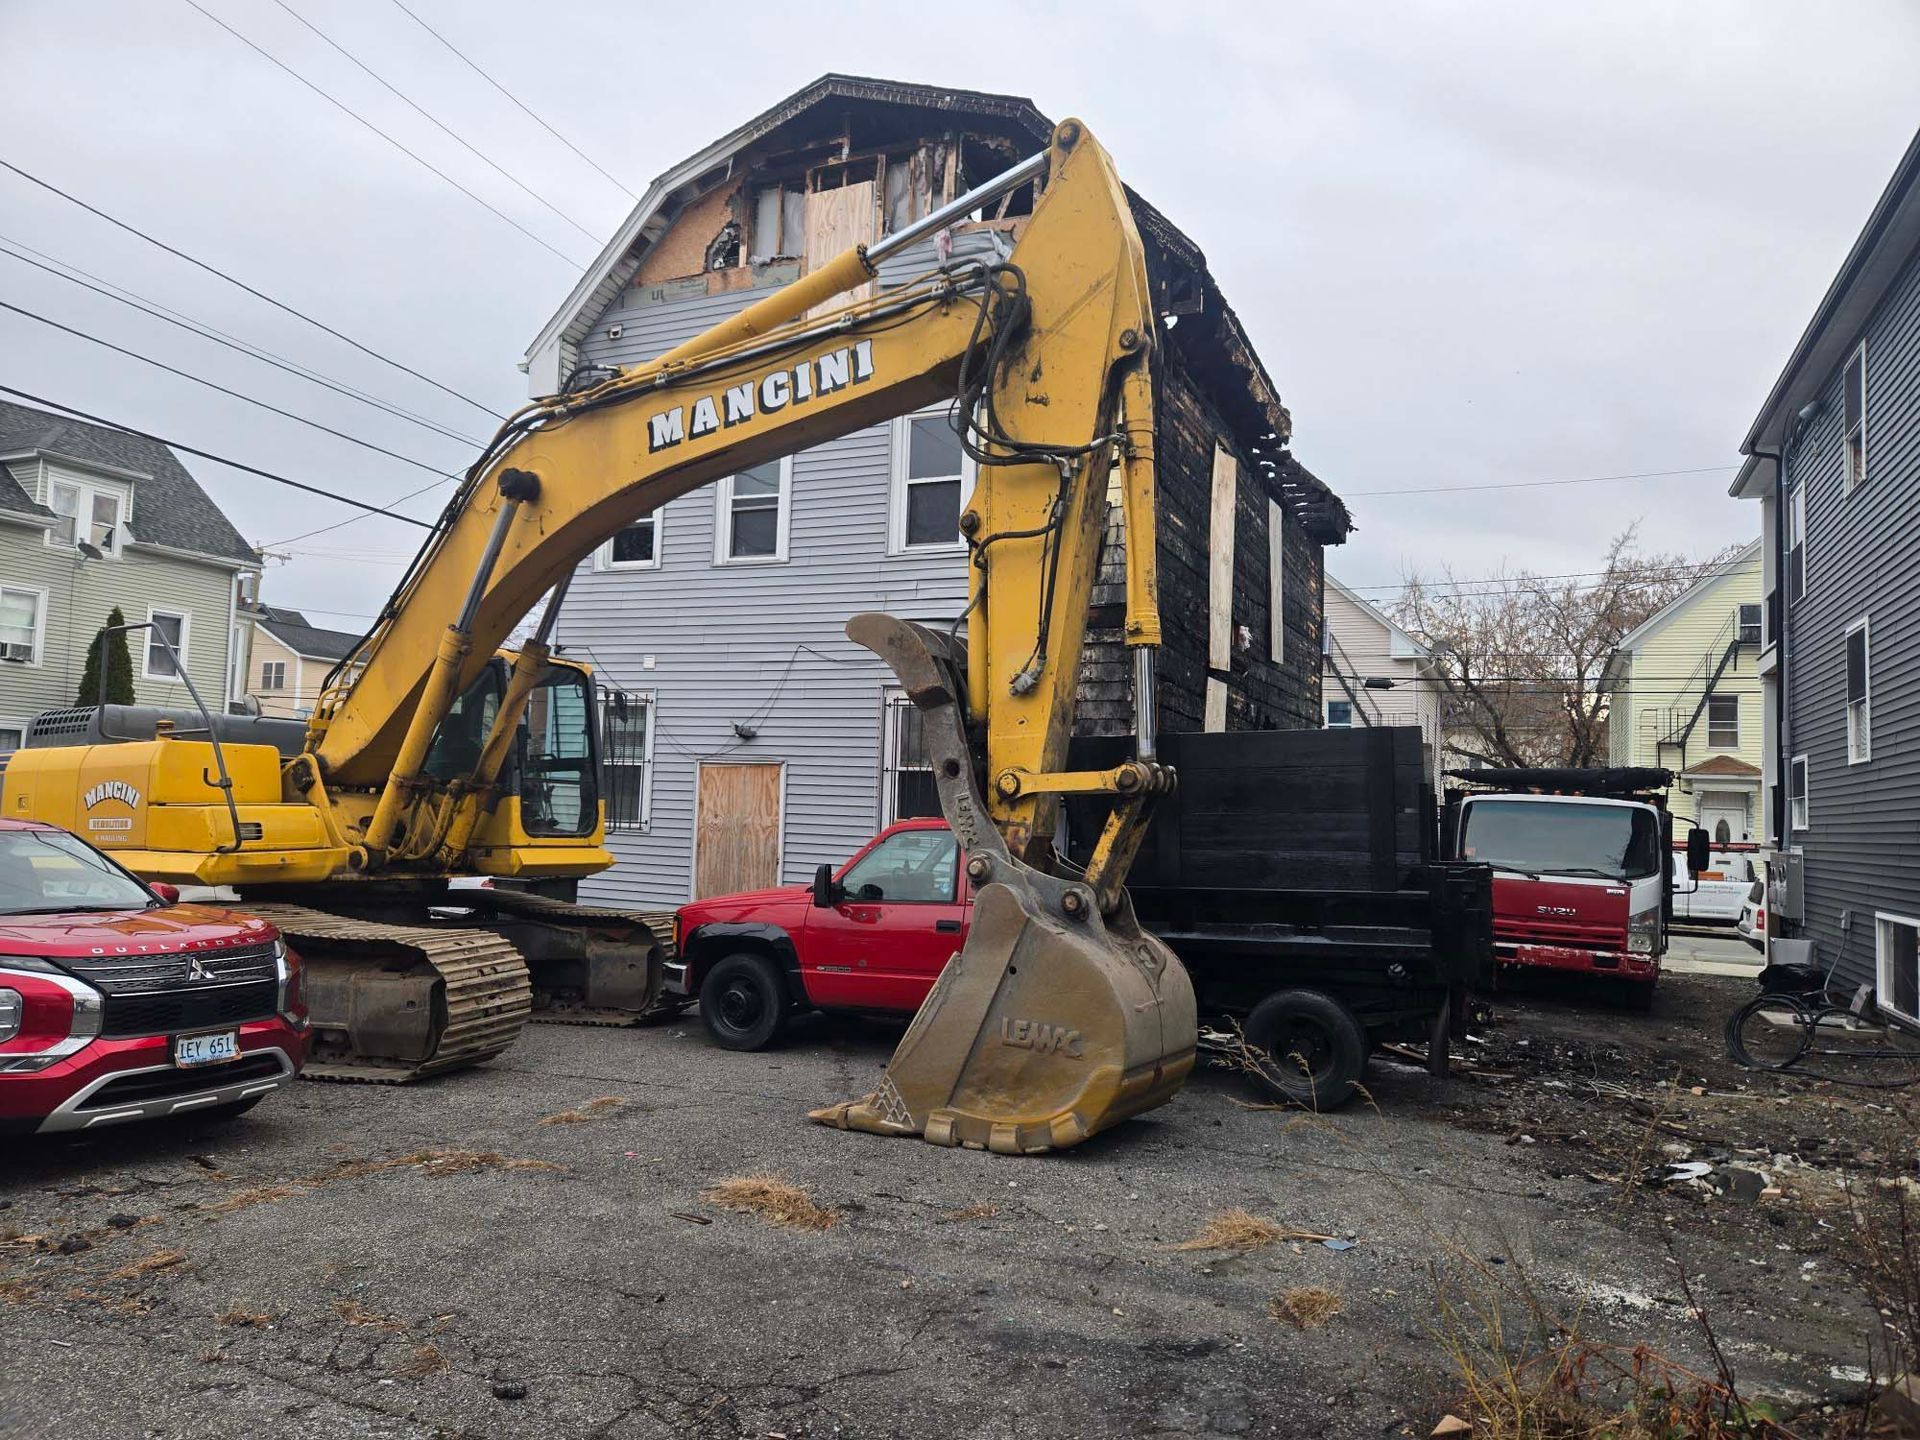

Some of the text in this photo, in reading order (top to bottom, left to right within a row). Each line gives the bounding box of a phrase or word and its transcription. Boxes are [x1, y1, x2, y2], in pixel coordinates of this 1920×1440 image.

[647, 338, 875, 454] MANCINI
[84, 781, 140, 811] MANCINI
[91, 938, 256, 954] OUTLANDER
[180, 1037, 232, 1059] 1EY 651
